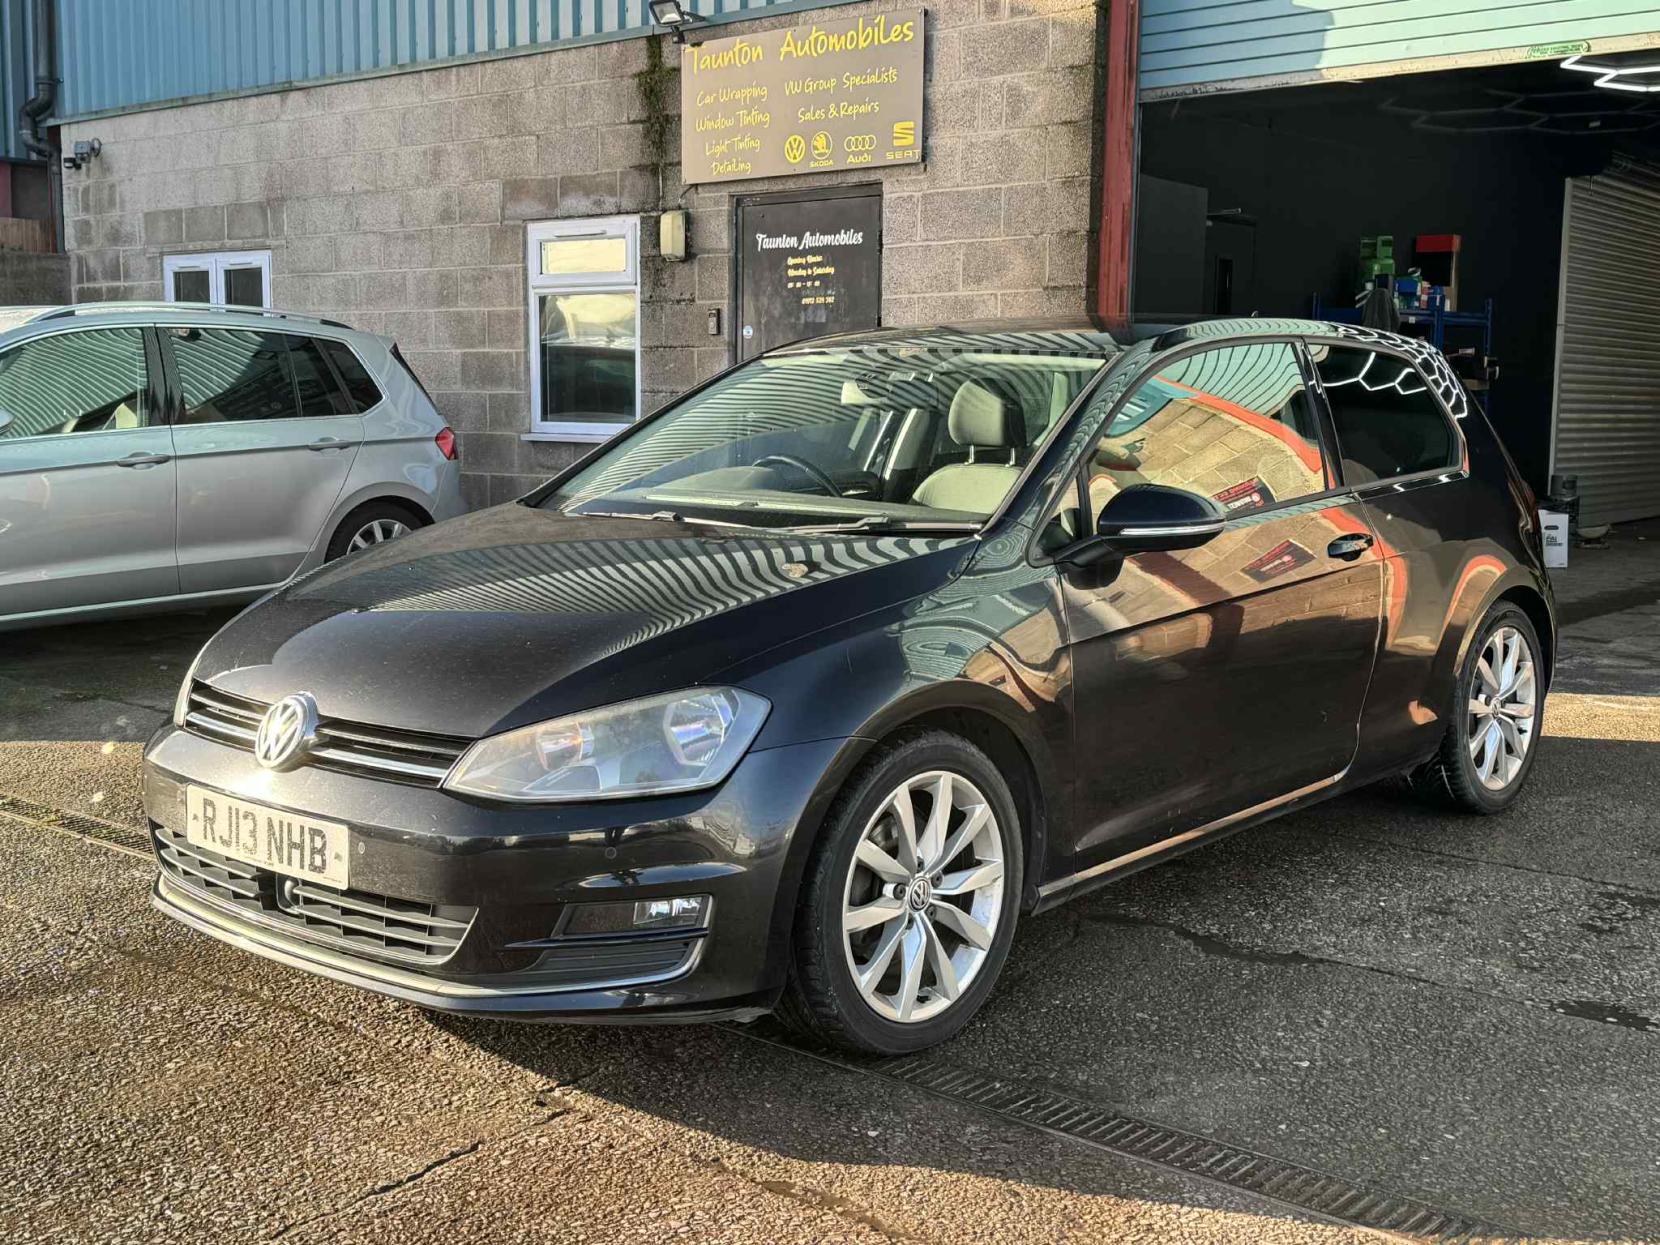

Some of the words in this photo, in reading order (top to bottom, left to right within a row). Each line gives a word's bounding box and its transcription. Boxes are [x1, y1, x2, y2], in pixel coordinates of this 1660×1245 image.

[684, 38, 763, 75] Taunton
[780, 14, 914, 61] Automobiles
[696, 90, 717, 107] Car
[719, 80, 768, 105] Wrapping
[784, 79, 802, 96] VW
[804, 77, 837, 95] Group
[842, 66, 898, 92] Specialists
[695, 112, 735, 133] Window
[736, 105, 770, 128] Tinting
[797, 105, 826, 123] Sales
[828, 103, 839, 119] &
[840, 97, 880, 120] Repairs
[705, 139, 730, 158] Light
[730, 132, 760, 153] Tinting
[885, 149, 921, 161] SEAT
[711, 158, 752, 176] Detailing
[846, 153, 873, 165] Audi
[755, 233, 798, 252] Taunton
[798, 229, 863, 250] Automobiles
[203, 797, 258, 856] RJ13
[267, 816, 327, 874] NHB
